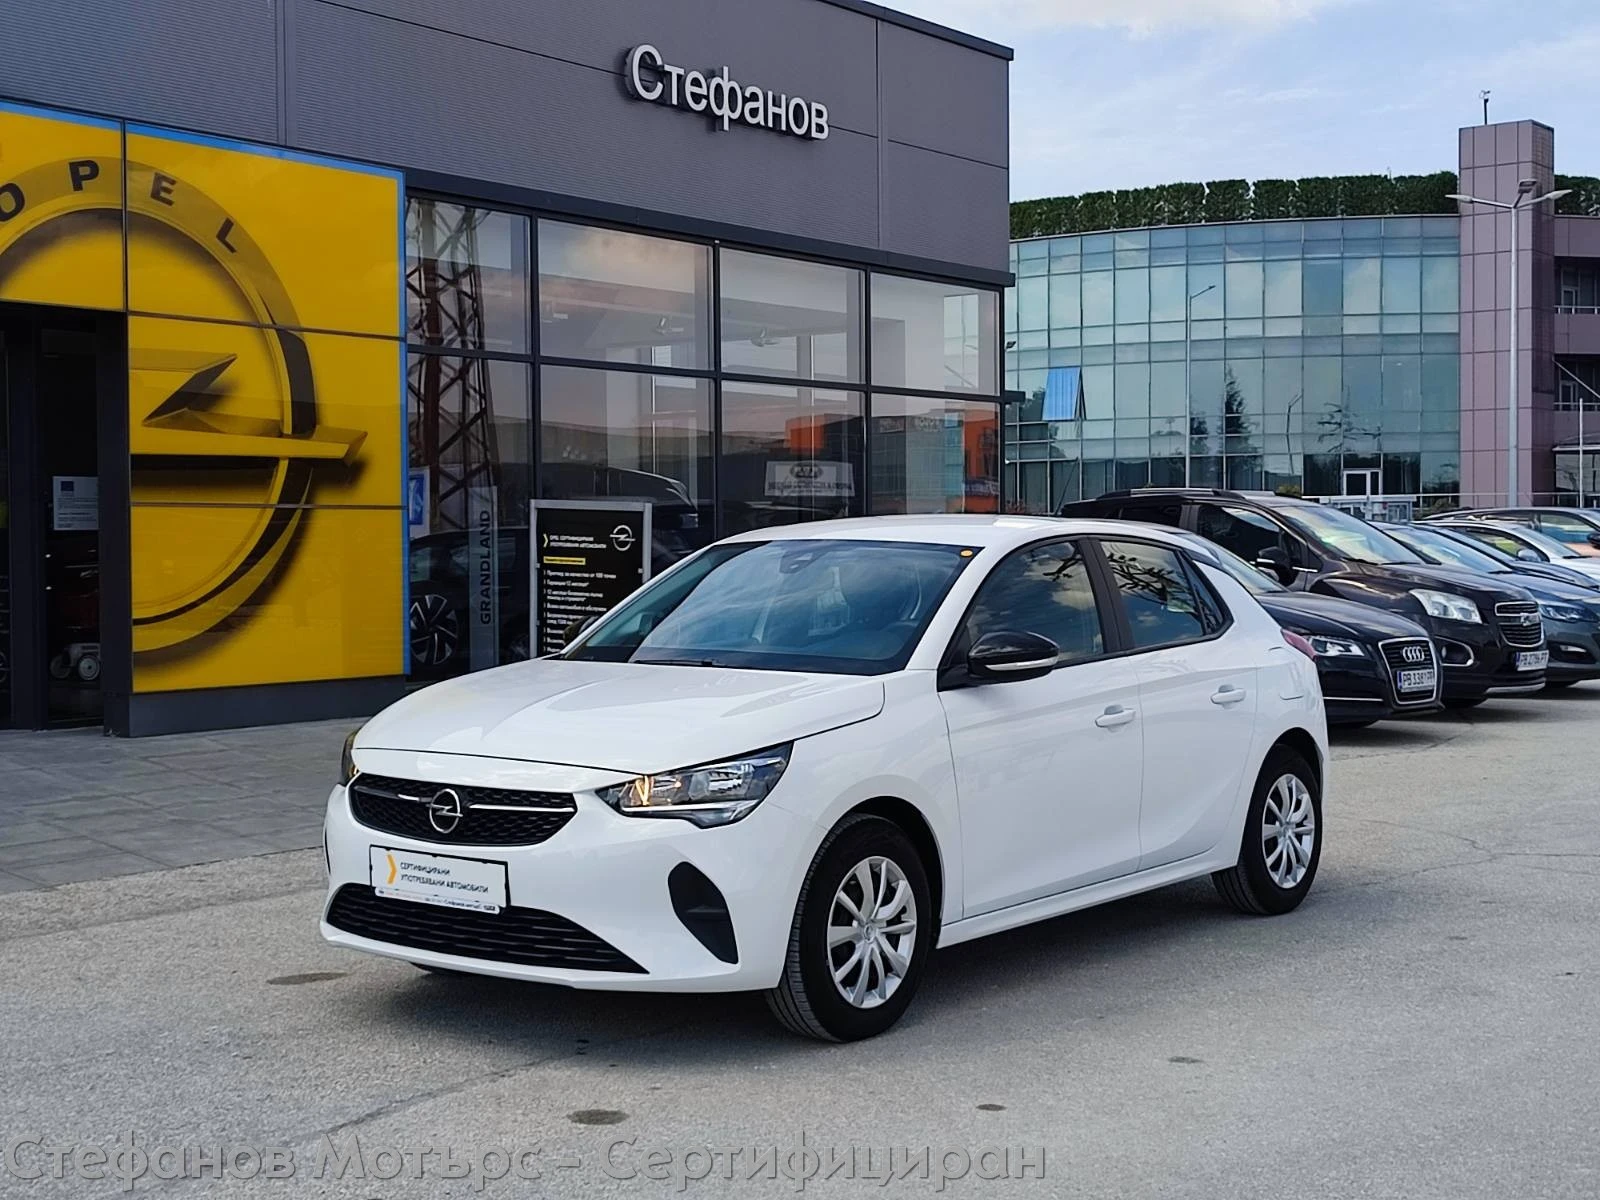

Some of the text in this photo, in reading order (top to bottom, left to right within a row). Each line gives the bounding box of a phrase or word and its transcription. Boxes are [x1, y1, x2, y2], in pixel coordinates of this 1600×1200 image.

[630, 44, 829, 140] Стефанов
[0, 159, 237, 253] OPEL
[480, 509, 491, 625] GRANDLAND
